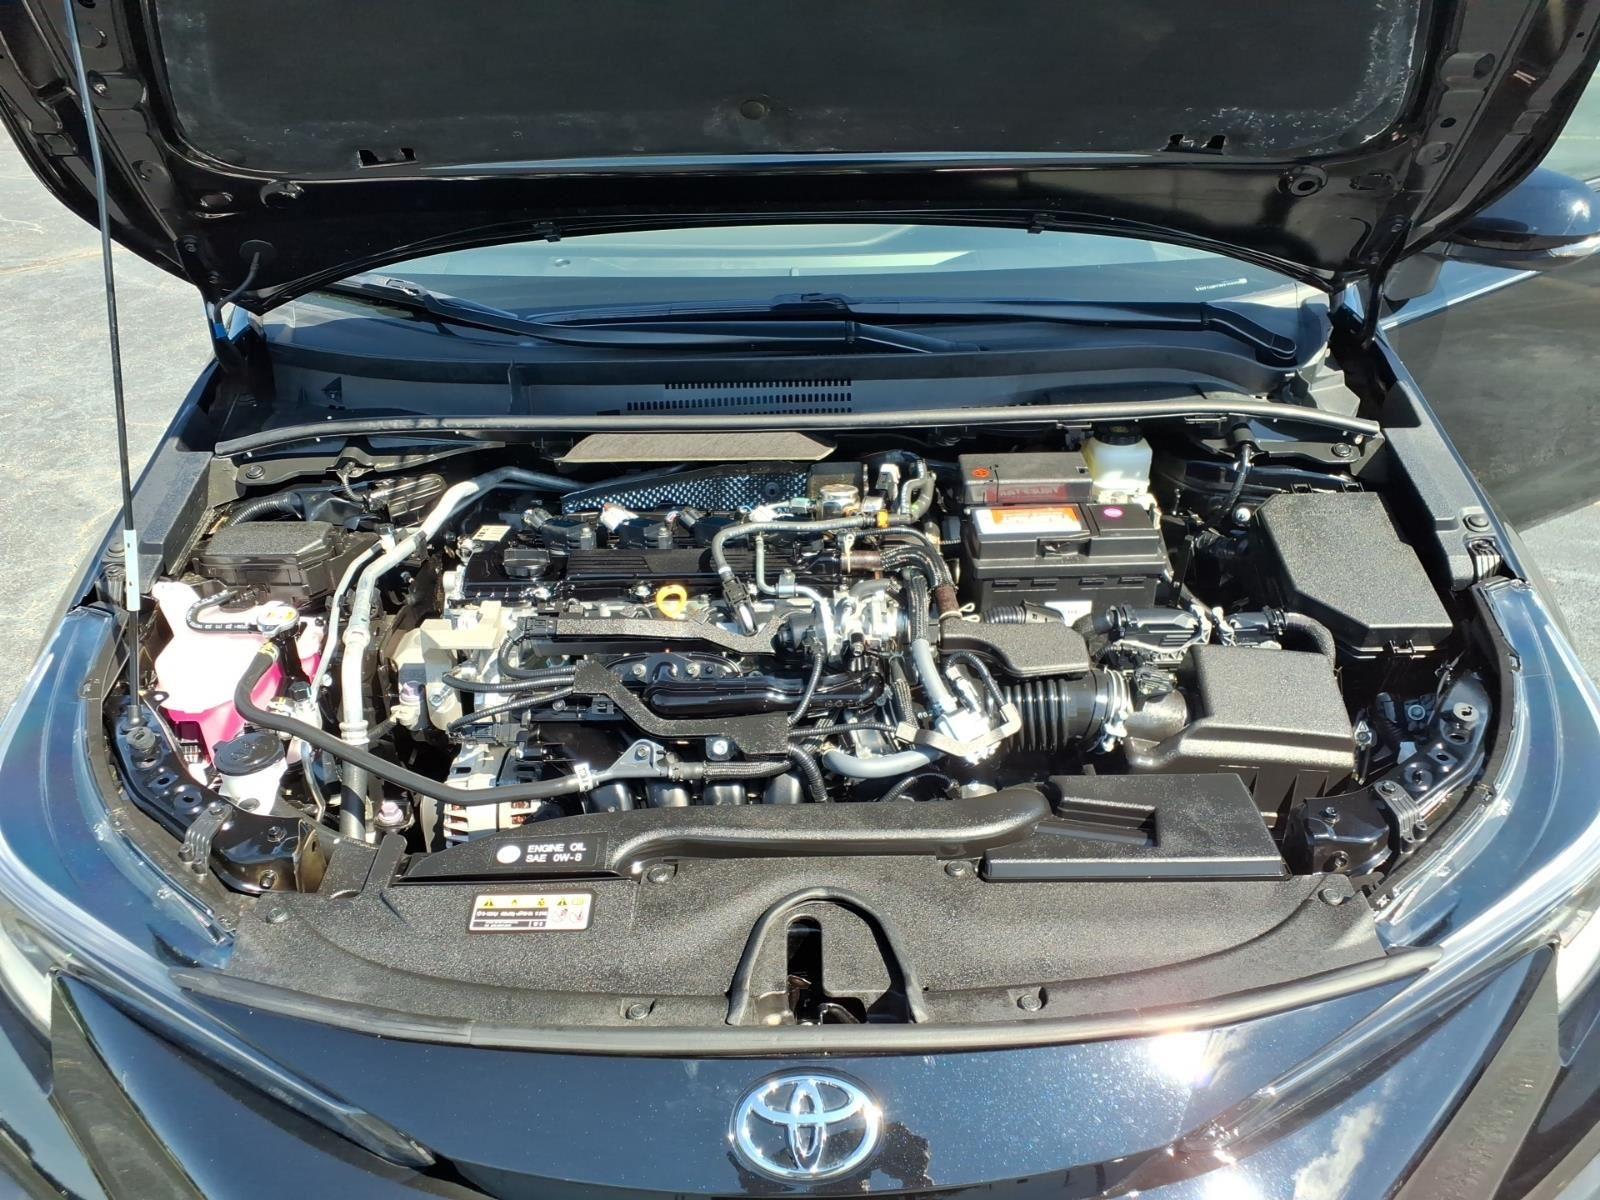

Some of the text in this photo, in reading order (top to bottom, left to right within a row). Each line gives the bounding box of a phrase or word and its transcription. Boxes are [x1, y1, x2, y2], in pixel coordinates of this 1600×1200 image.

[527, 842, 587, 853] ENGINE OIL
[525, 854, 547, 863] SAE
